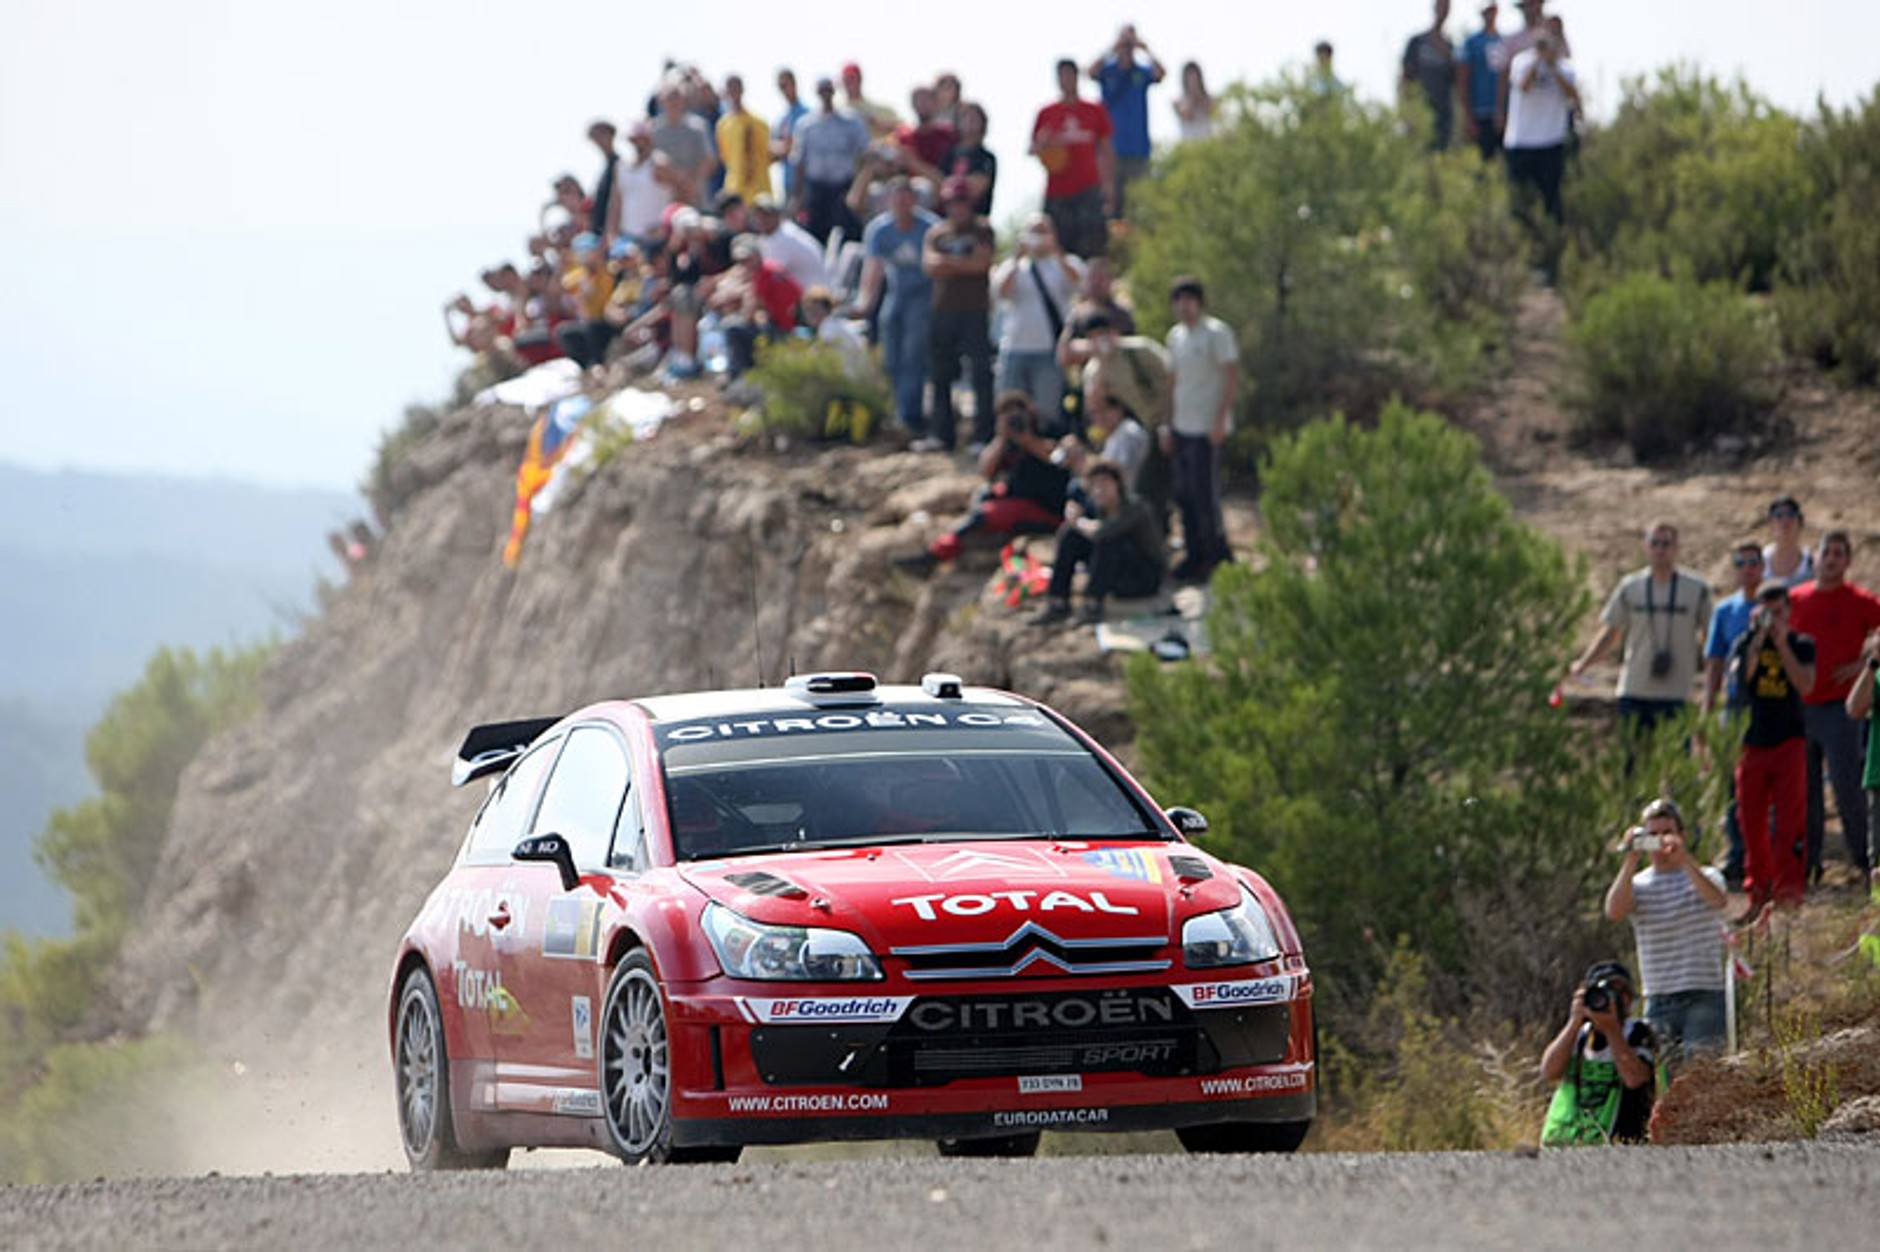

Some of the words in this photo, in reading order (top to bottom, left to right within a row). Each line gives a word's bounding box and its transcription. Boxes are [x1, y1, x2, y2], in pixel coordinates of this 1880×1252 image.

[668, 709, 946, 740] CITROËN
[892, 890, 1140, 921] TOTAL
[455, 961, 508, 1011] TOTAL
[1192, 981, 1285, 1000] BFGoodrich
[771, 999, 898, 1016] BFGoodrich
[910, 990, 1173, 1031] CITROËN
[1082, 1044, 1176, 1065] SPORT
[728, 1094, 888, 1111] WWW.CITROEN.COM
[993, 1108, 1109, 1126] EURODATACAR
